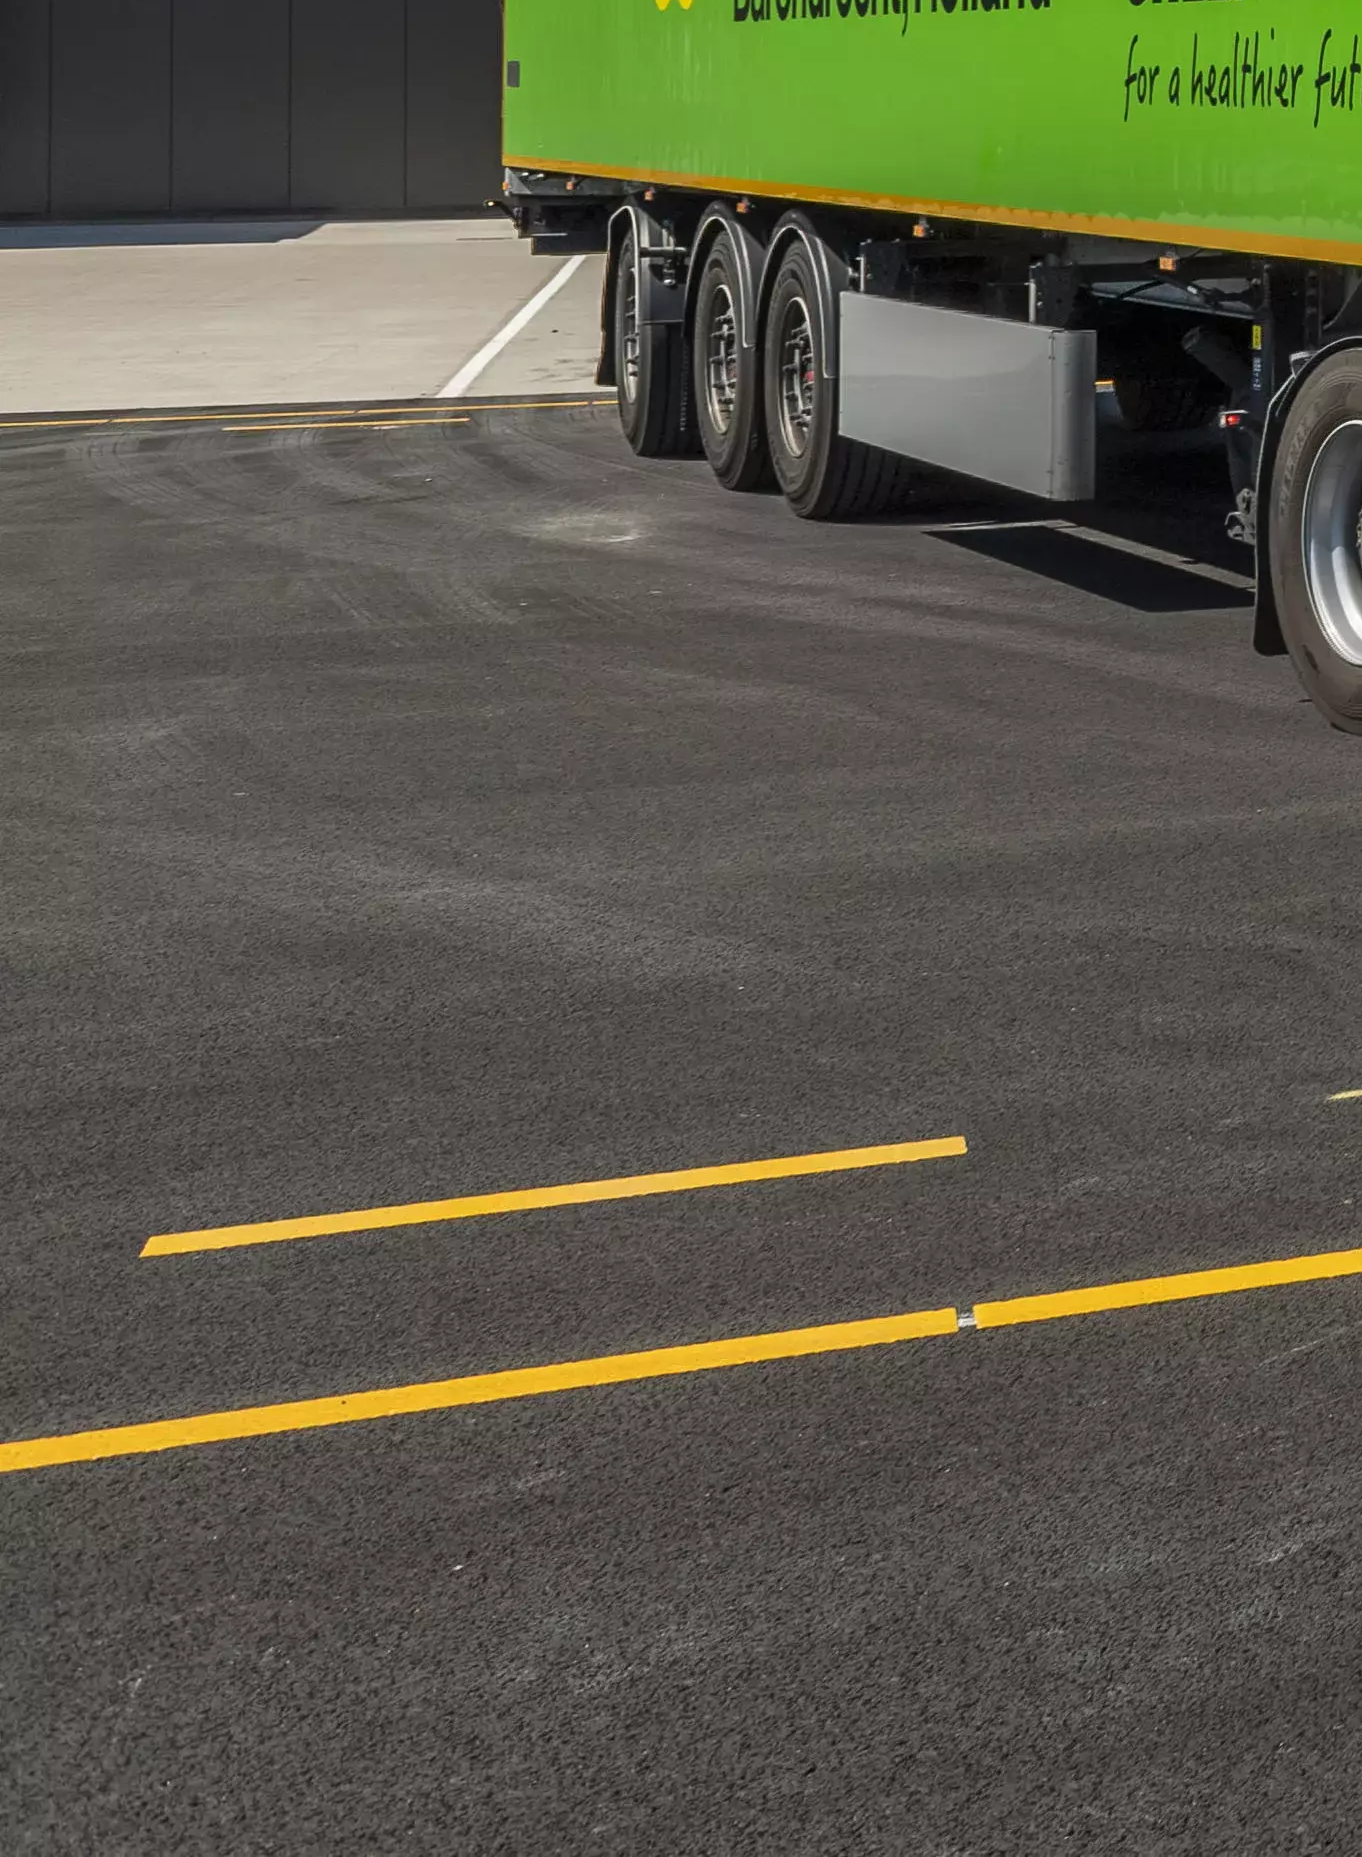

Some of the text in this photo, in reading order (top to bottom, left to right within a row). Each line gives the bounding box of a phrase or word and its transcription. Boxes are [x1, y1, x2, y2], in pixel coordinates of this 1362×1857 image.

[1124, 34, 1160, 123] for
[1168, 66, 1180, 107] a
[1191, 27, 1304, 109] healthier
